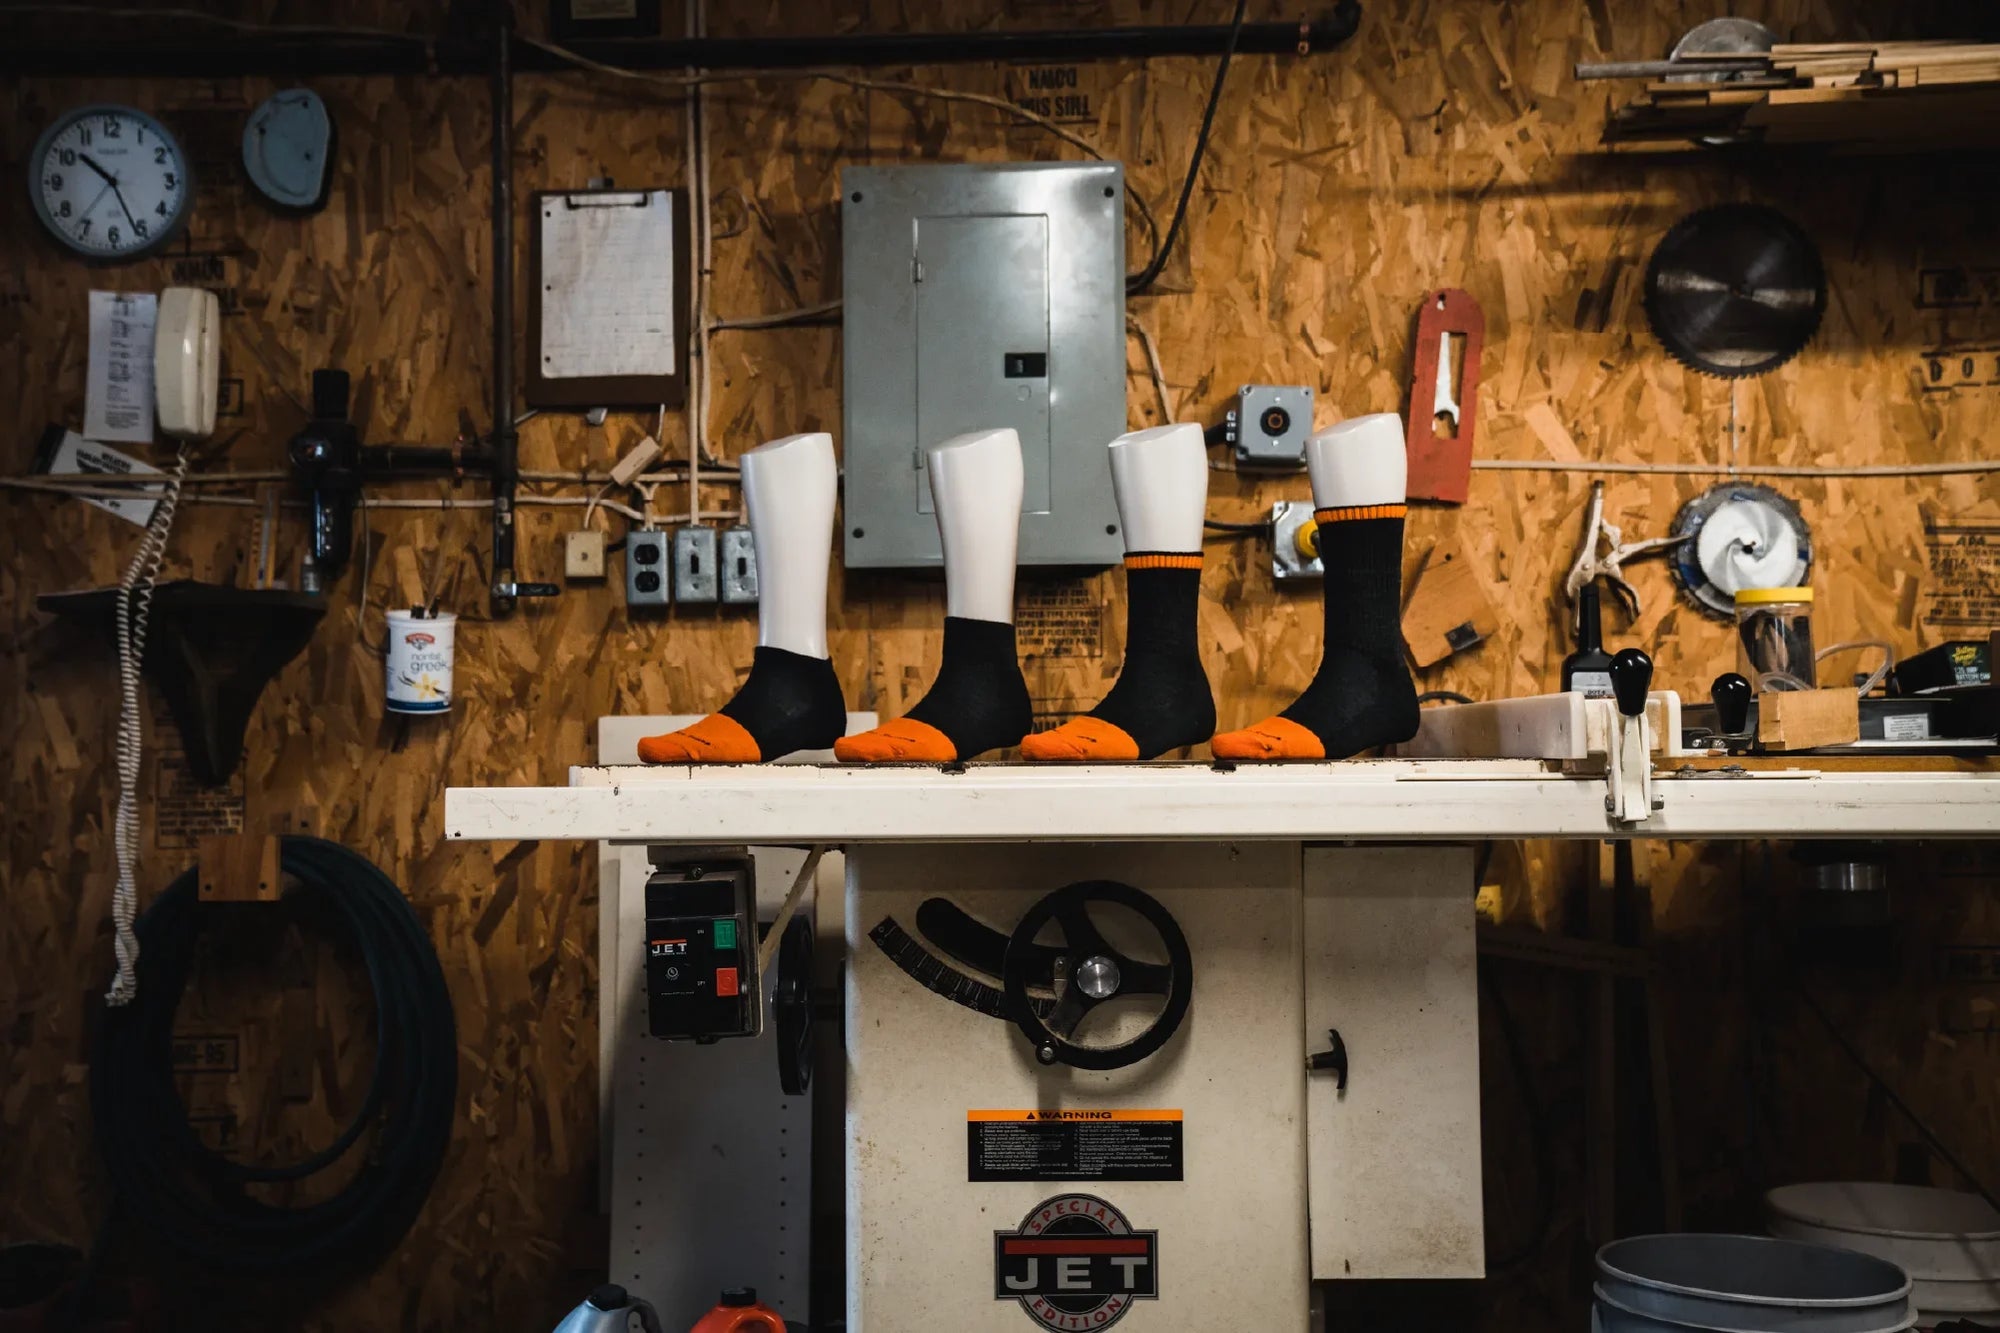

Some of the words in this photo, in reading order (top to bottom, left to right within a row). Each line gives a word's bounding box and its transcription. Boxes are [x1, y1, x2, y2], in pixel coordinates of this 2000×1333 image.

[79, 127, 92, 145] 11
[103, 121, 120, 138] 12
[59, 150, 77, 166] 10
[154, 147, 166, 164] 2
[51, 173, 63, 191] 9
[163, 173, 176, 190] 3
[59, 201, 72, 217] 8
[155, 201, 167, 217] 4
[82, 219, 92, 236] 7
[108, 227, 120, 243] 6
[135, 219, 148, 237] 5
[410, 660, 448, 675] greek
[651, 943, 687, 954] JET
[1039, 1111, 1113, 1119] WARNING
[1031, 1200, 1117, 1232] SPECIAL
[1004, 1256, 1149, 1290] JET
[1032, 1297, 1122, 1329] EDITION
